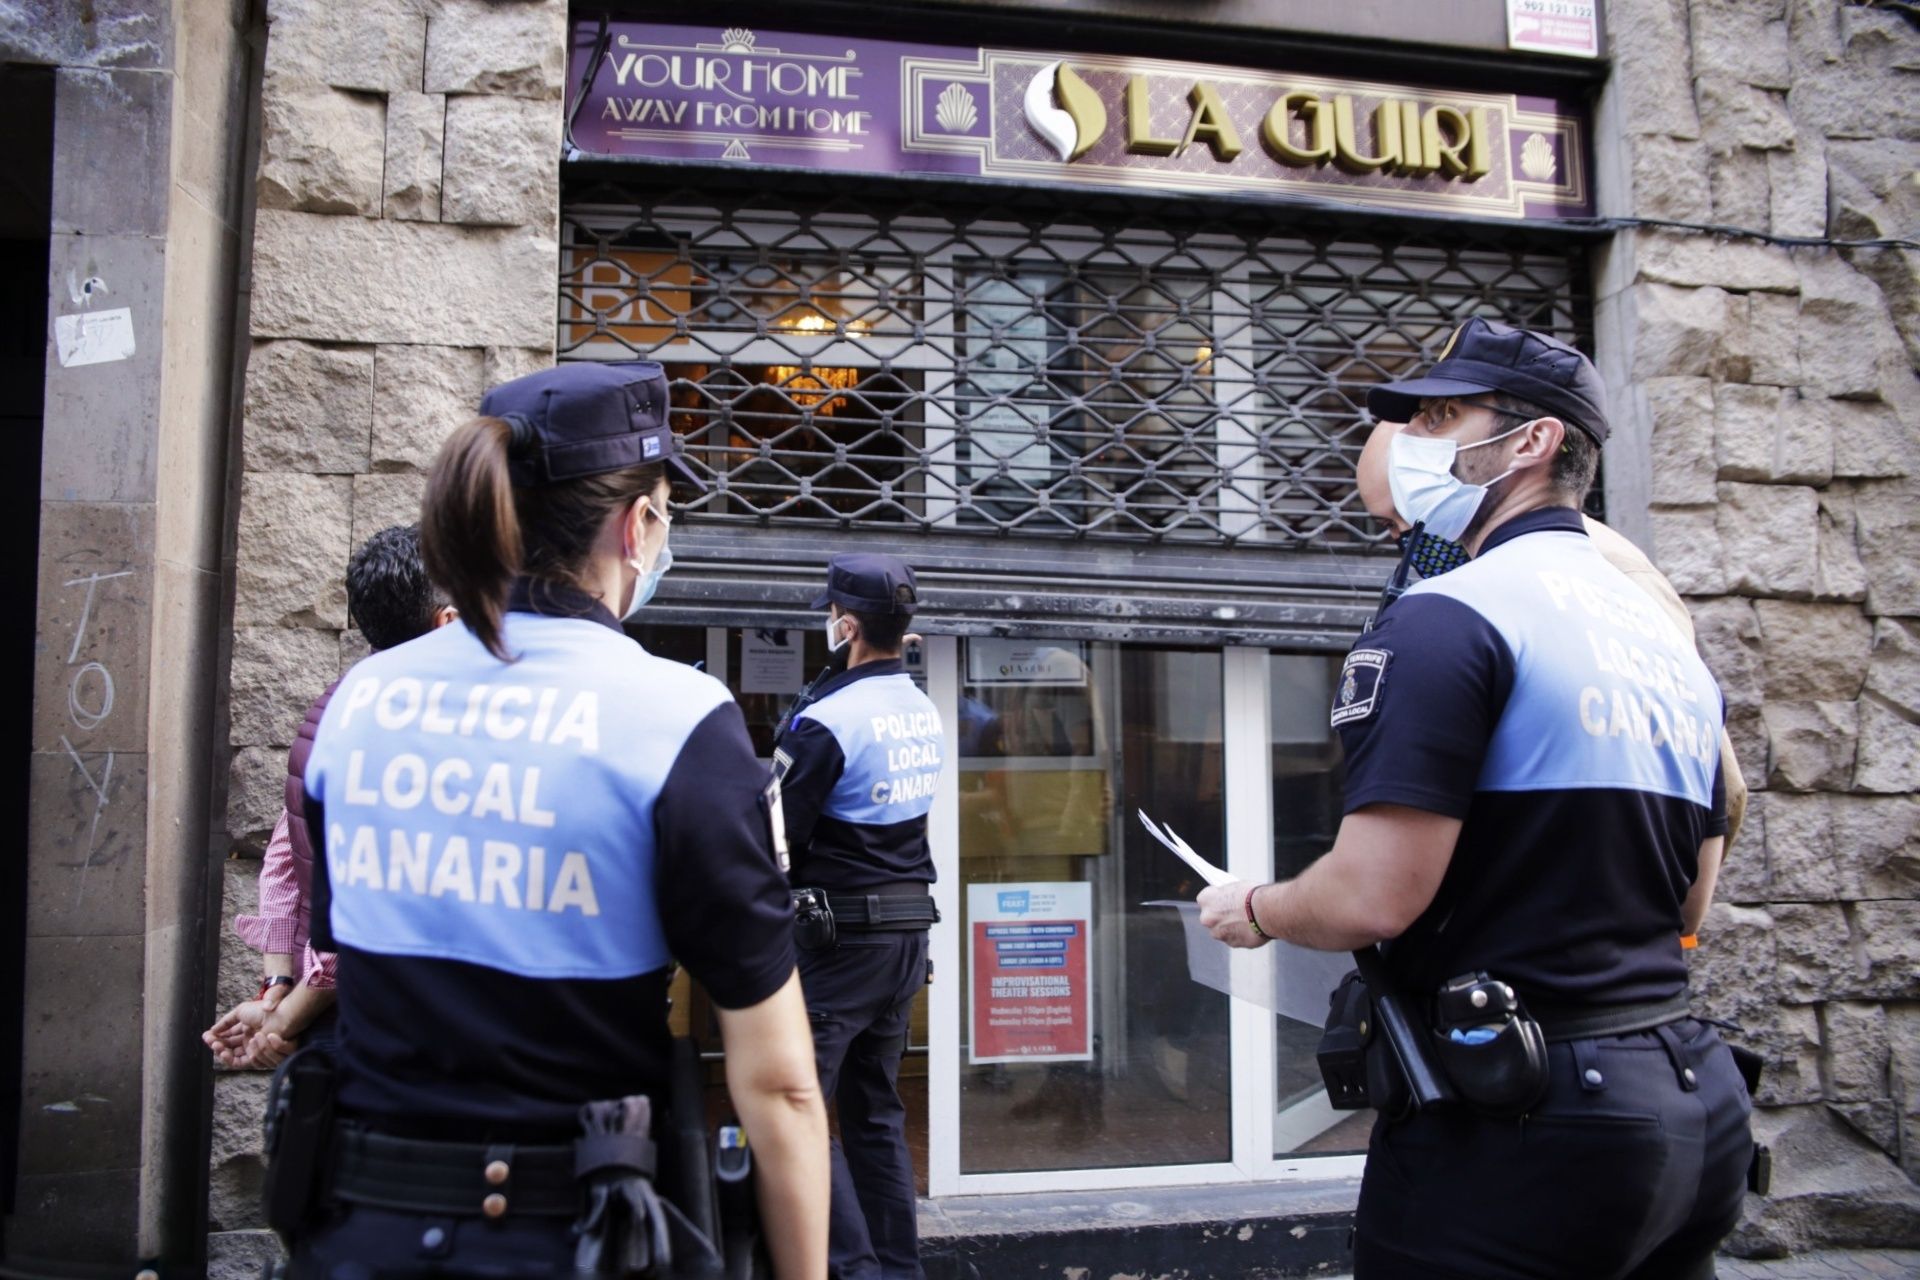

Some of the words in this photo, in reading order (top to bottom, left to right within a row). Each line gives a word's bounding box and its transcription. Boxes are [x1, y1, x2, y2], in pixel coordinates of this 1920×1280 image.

[1524, 1, 1545, 12] 902
[1550, 3, 1568, 14] 121
[1573, 6, 1593, 17] 122
[607, 52, 755, 102] YOUR
[743, 60, 864, 100] HOME
[601, 96, 688, 124] AWAY
[696, 101, 781, 129] FROM
[788, 106, 872, 135] HOME
[1127, 74, 1243, 162] LA
[1262, 90, 1490, 182] GUIRI
[1586, 630, 1698, 704] LOCAL
[339, 676, 600, 752] POLICIA
[1349, 705, 1369, 716] LOCAL
[888, 743, 941, 772] LOCAL
[345, 749, 556, 828] LOCAL
[329, 822, 600, 917] CANARIA
[991, 987, 1028, 998] THEATER
[1029, 986, 1072, 997] SESSIONS
[992, 976, 1069, 987] IMPROVISATIONAL
